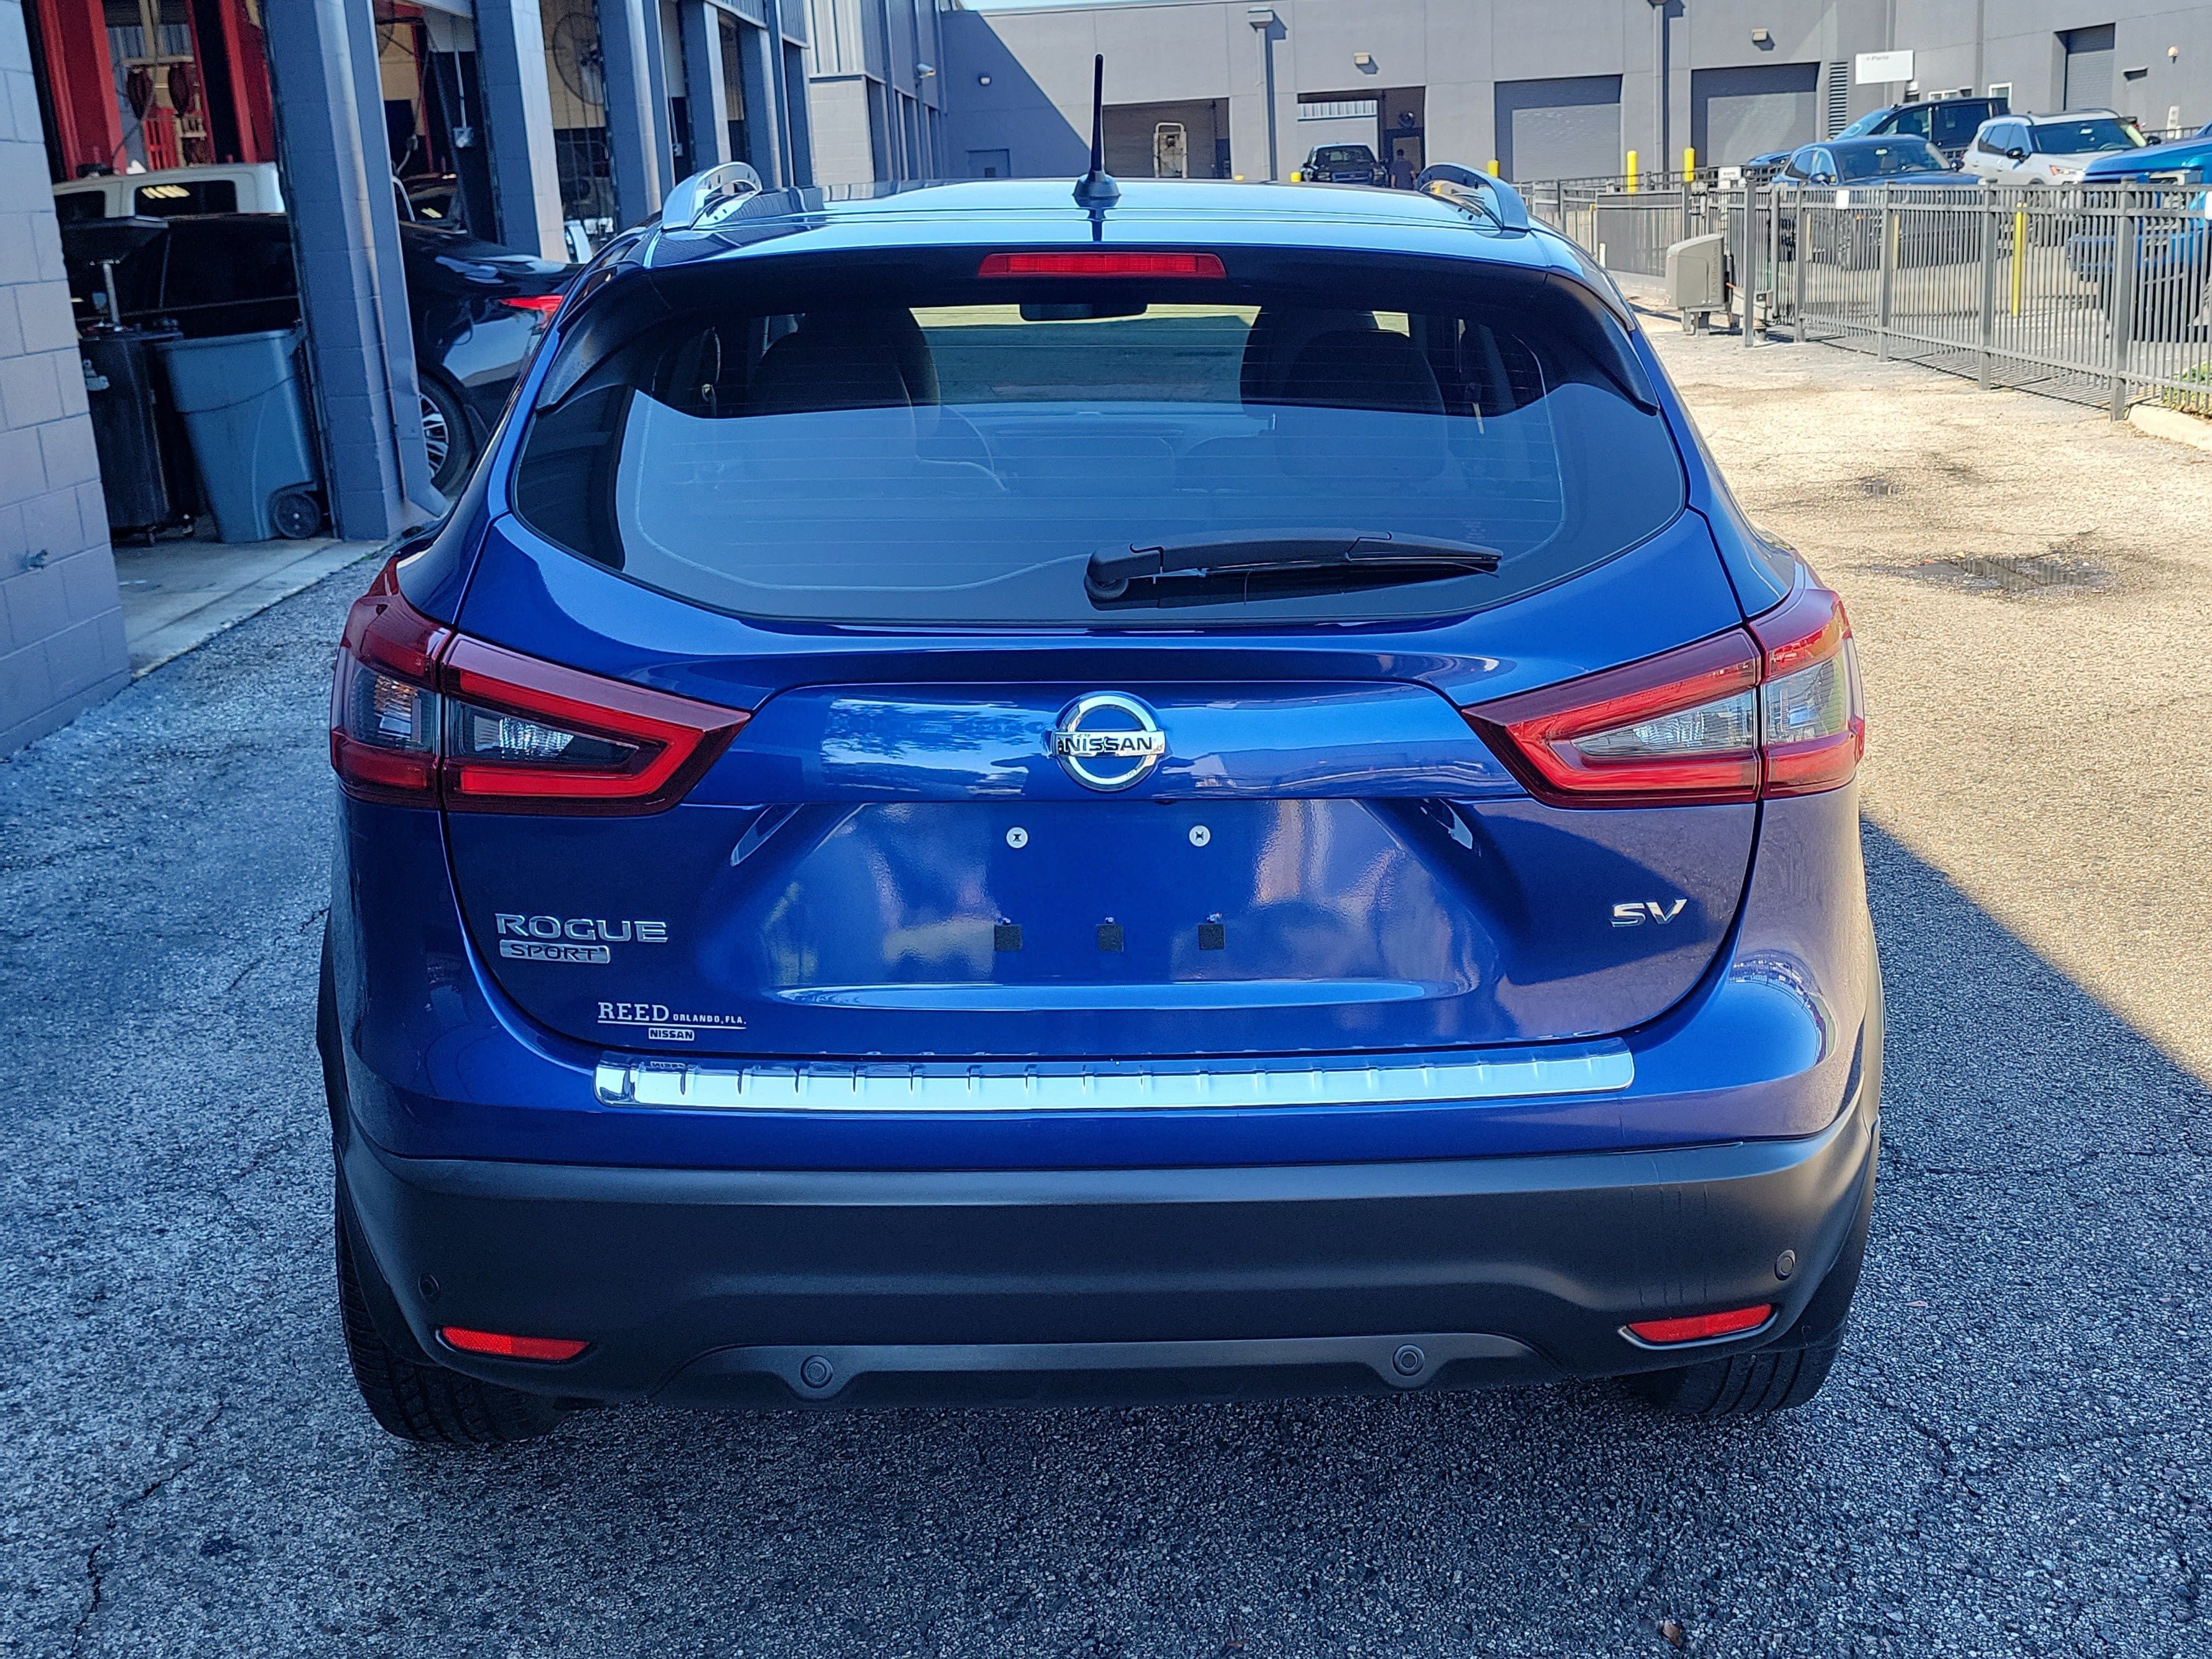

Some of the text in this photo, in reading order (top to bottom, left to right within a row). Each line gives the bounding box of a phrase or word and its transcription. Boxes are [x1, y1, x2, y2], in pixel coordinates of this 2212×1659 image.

[1063, 736, 1153, 752] NISSAN
[1610, 899, 1688, 927] SV
[495, 913, 668, 943] ROGUE
[511, 943, 599, 961] SPORT
[598, 1002, 669, 1022] REED
[650, 1029, 693, 1039] NISSAN
